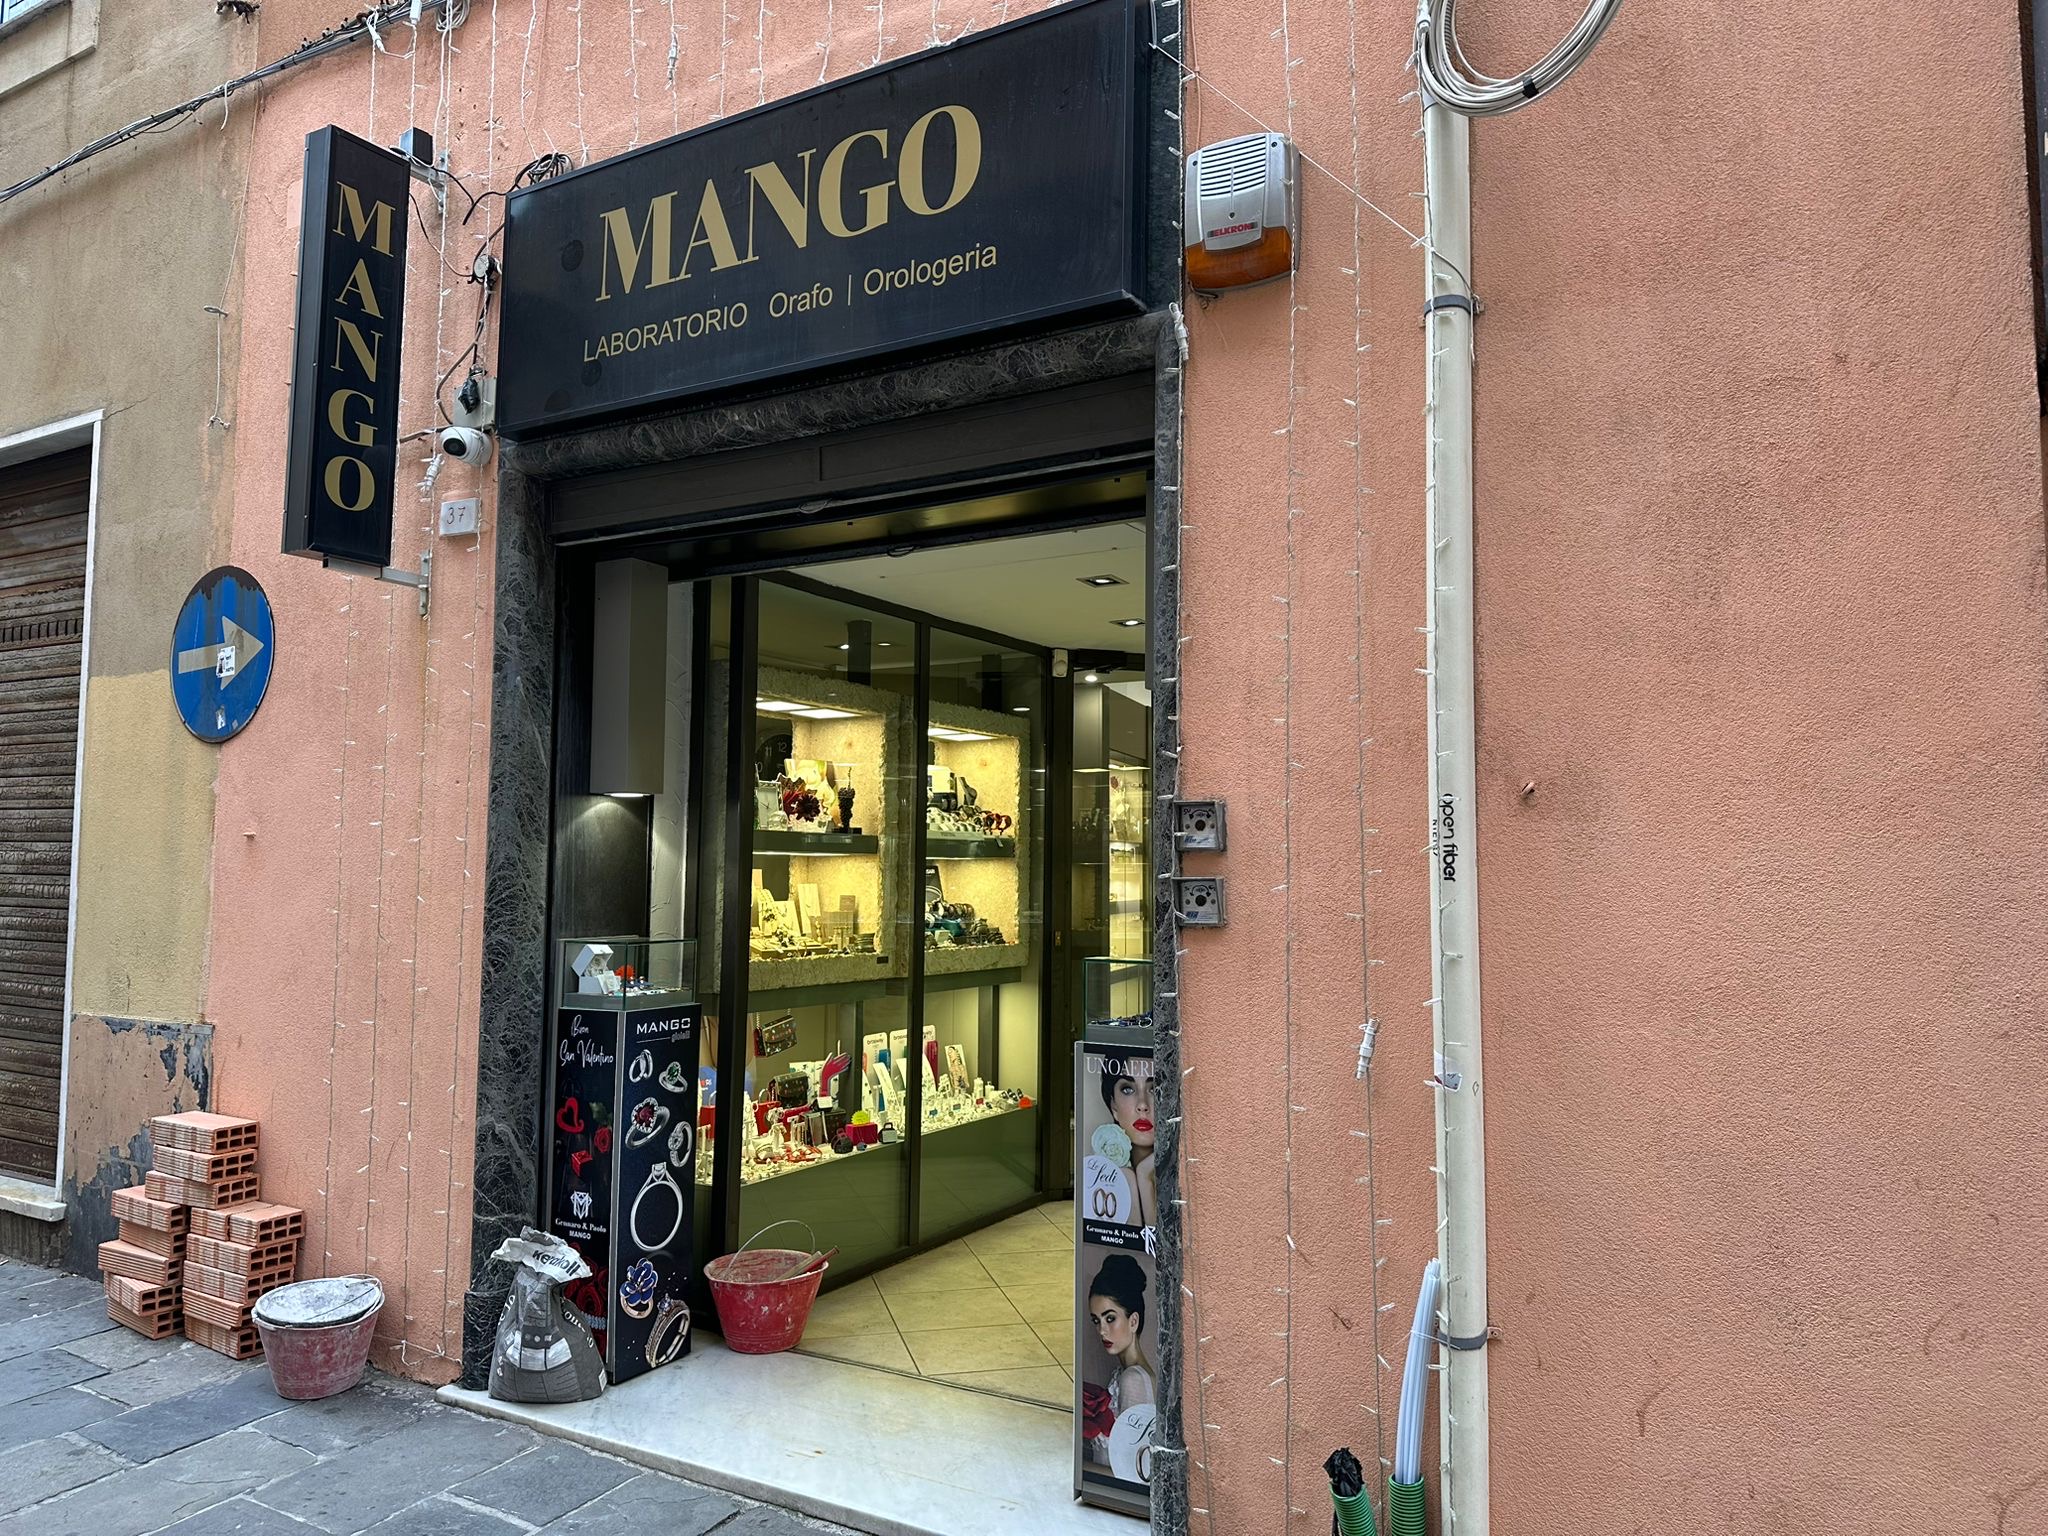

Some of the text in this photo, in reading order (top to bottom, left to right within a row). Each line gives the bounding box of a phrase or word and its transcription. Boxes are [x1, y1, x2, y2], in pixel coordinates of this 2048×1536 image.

[595, 105, 982, 301] MANGO
[1213, 223, 1253, 237] ELKRON
[583, 303, 748, 362] LABORATORIO
[769, 283, 833, 318] Orafo
[864, 242, 997, 295] Orologeria
[324, 181, 396, 512] MANGO
[447, 506, 466, 525] 37
[1439, 793, 1459, 882] open fiber
[636, 1017, 691, 1035] MANGO
[560, 1039, 614, 1069] San Valentino
[555, 1217, 581, 1229] Gennaro
[589, 1223, 607, 1233] Paolo
[1086, 1224, 1113, 1235] Gennaro
[1121, 1230, 1139, 1239] Paolo
[569, 1230, 591, 1240] MANGO
[1101, 1235, 1124, 1245] MANGO
